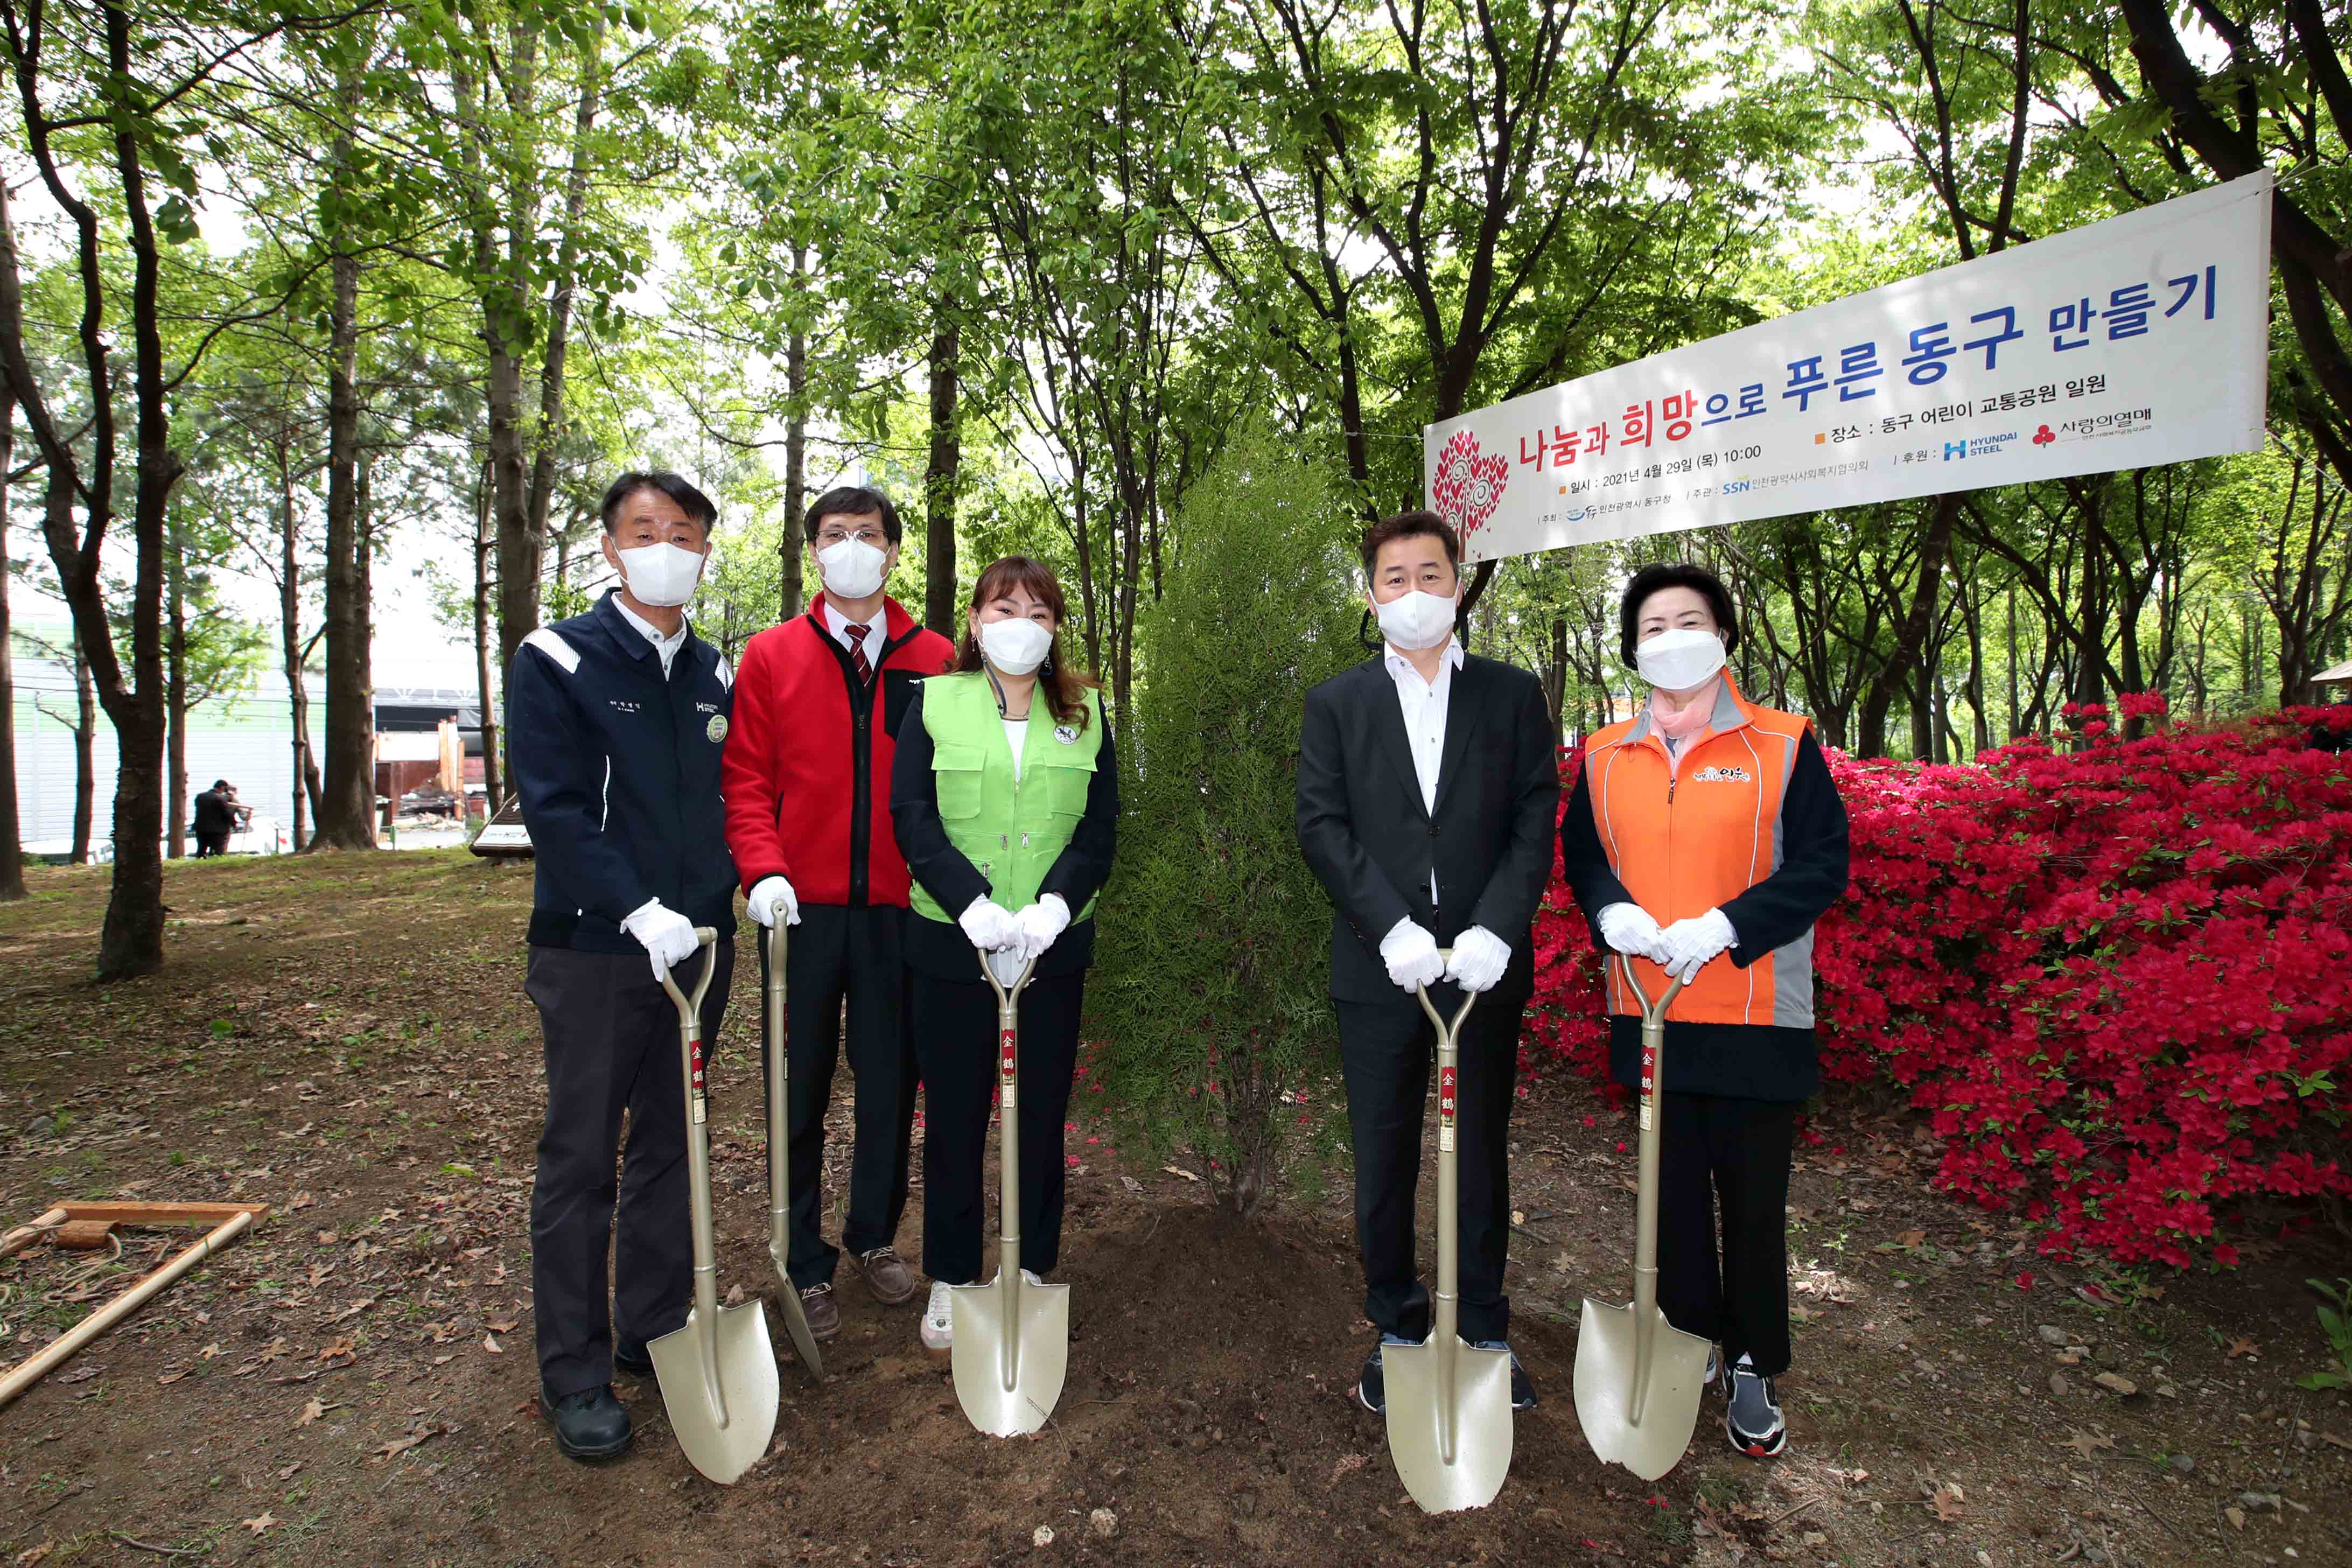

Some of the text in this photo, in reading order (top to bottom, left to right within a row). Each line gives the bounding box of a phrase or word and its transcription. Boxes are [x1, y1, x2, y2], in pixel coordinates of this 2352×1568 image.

[1520, 265, 2216, 472] 나눔과 희망으로 푸른 동구 만들기
[1830, 427, 1862, 444] 장소
[1881, 413, 1914, 435] 동구
[1921, 401, 1973, 425] 어린이
[1980, 384, 2056, 415] 교통공원
[2065, 374, 2107, 400] 일원
[2060, 408, 2152, 435] 사랑의열매
[1970, 431, 2018, 447] HYUNDAI
[1902, 450, 1928, 465] 후원
[1970, 445, 2003, 457] STEEL
[1571, 479, 1590, 494] 일시
[1603, 469, 1640, 488] 2021년
[1643, 464, 1662, 479] 4월
[1667, 458, 1692, 473] 29일
[1697, 452, 1719, 471] (목)
[1724, 445, 1761, 463] 10:00
[1723, 480, 1749, 495] SSN
[1599, 499, 1641, 515] 인천광역시
